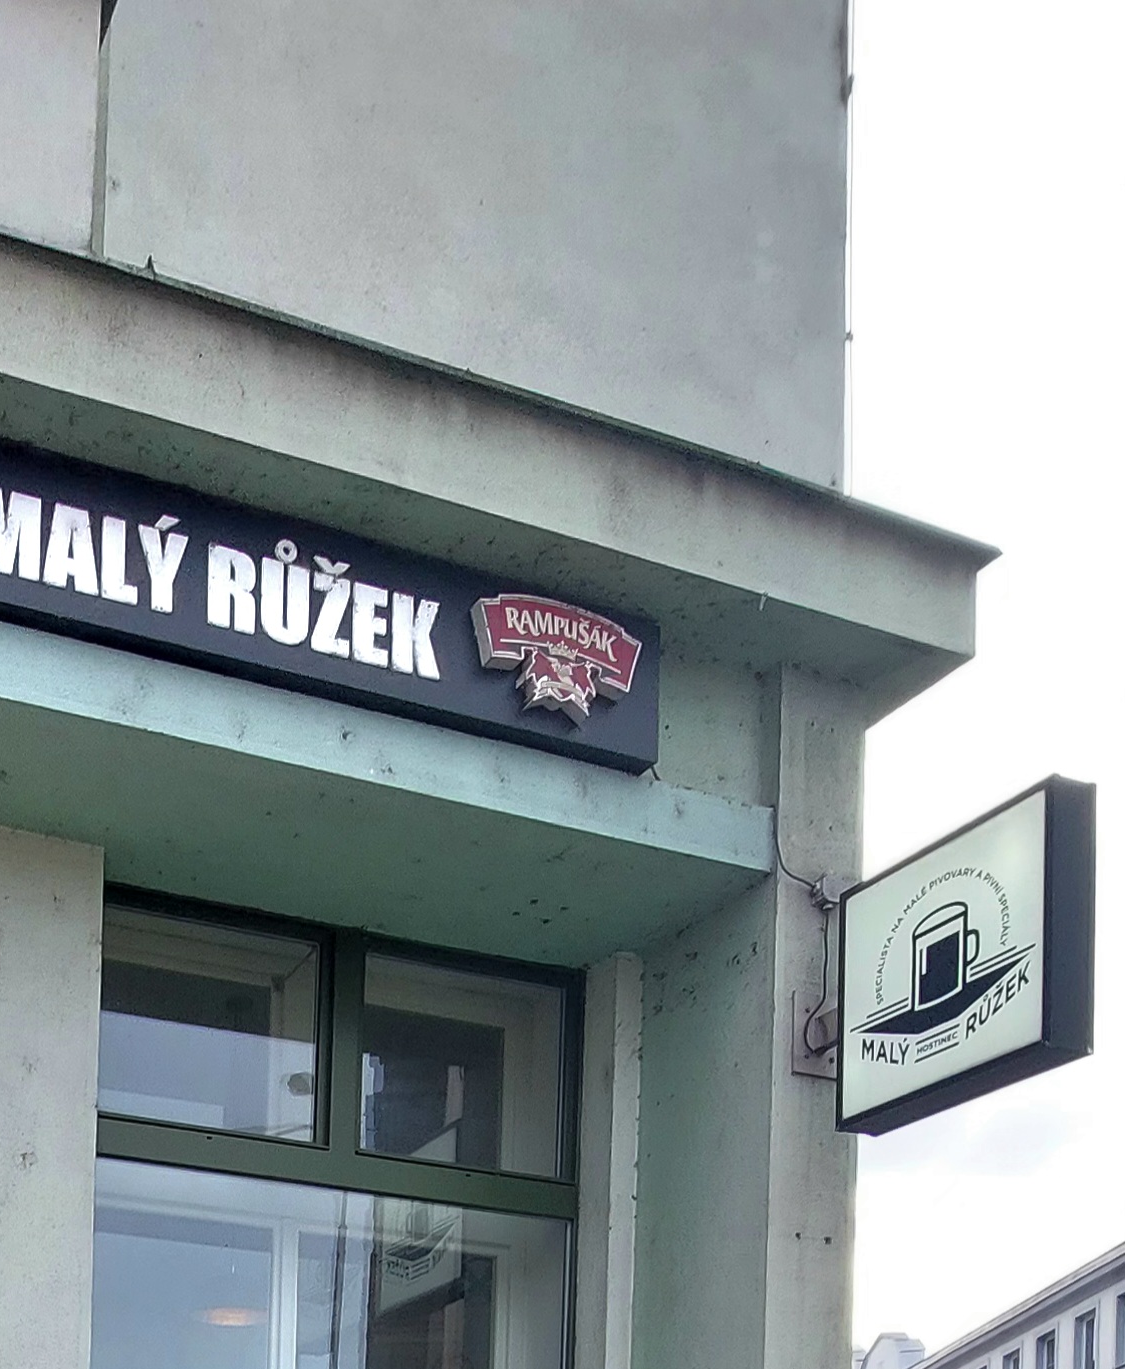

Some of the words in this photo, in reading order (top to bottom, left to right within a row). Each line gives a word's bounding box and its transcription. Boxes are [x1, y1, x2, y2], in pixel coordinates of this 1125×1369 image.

[206, 539, 441, 681] RŮŽEK
[506, 606, 618, 662] RAMPUŠÁK
[875, 936, 894, 1005] SPECIALISTA
[891, 917, 904, 933] NA
[929, 867, 976, 891] PIVOVARY
[976, 870, 983, 880] A
[861, 1038, 910, 1066] MALÝ
[916, 1031, 958, 1055] HOSTINEC
[965, 960, 1031, 1040] RŮŽEK
